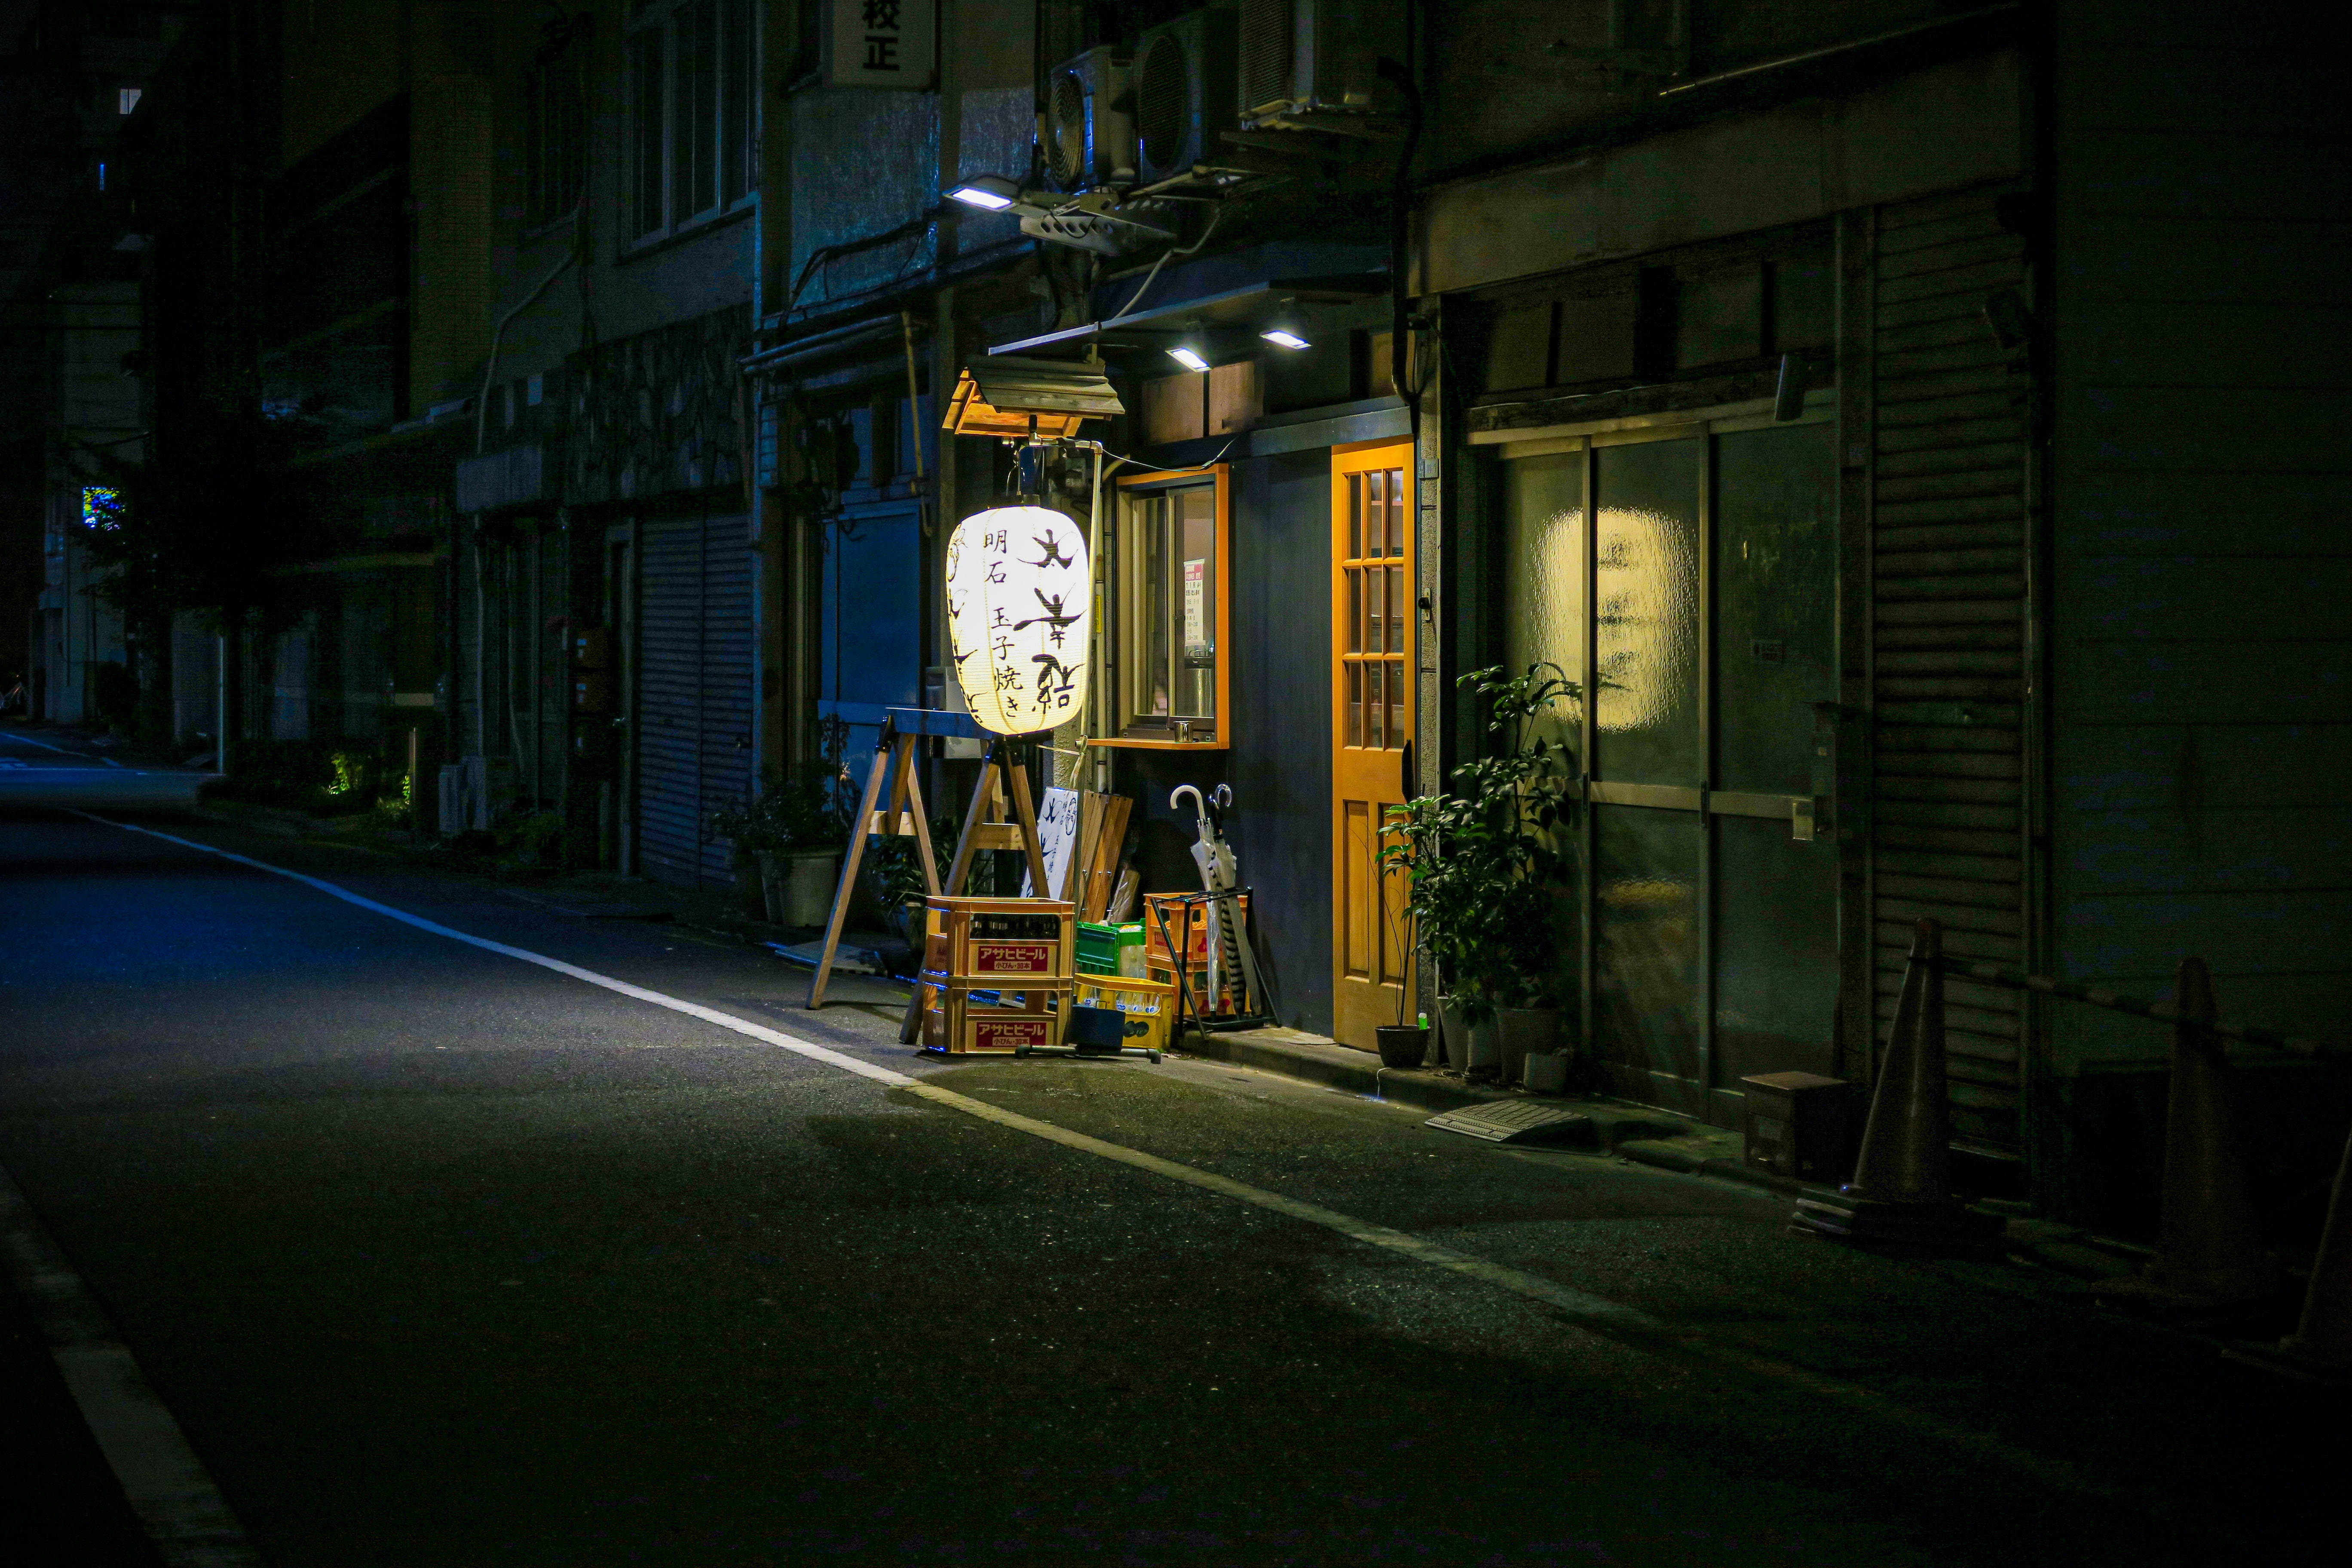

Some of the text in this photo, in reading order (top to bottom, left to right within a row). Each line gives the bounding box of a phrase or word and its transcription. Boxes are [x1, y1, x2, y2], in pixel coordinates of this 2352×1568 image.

[862, 0, 900, 71] 校正
[983, 530, 1023, 717] 明石 玉子焼き
[980, 948, 1046, 960] アサヒビール
[979, 1024, 1044, 1036] アサヒビール
